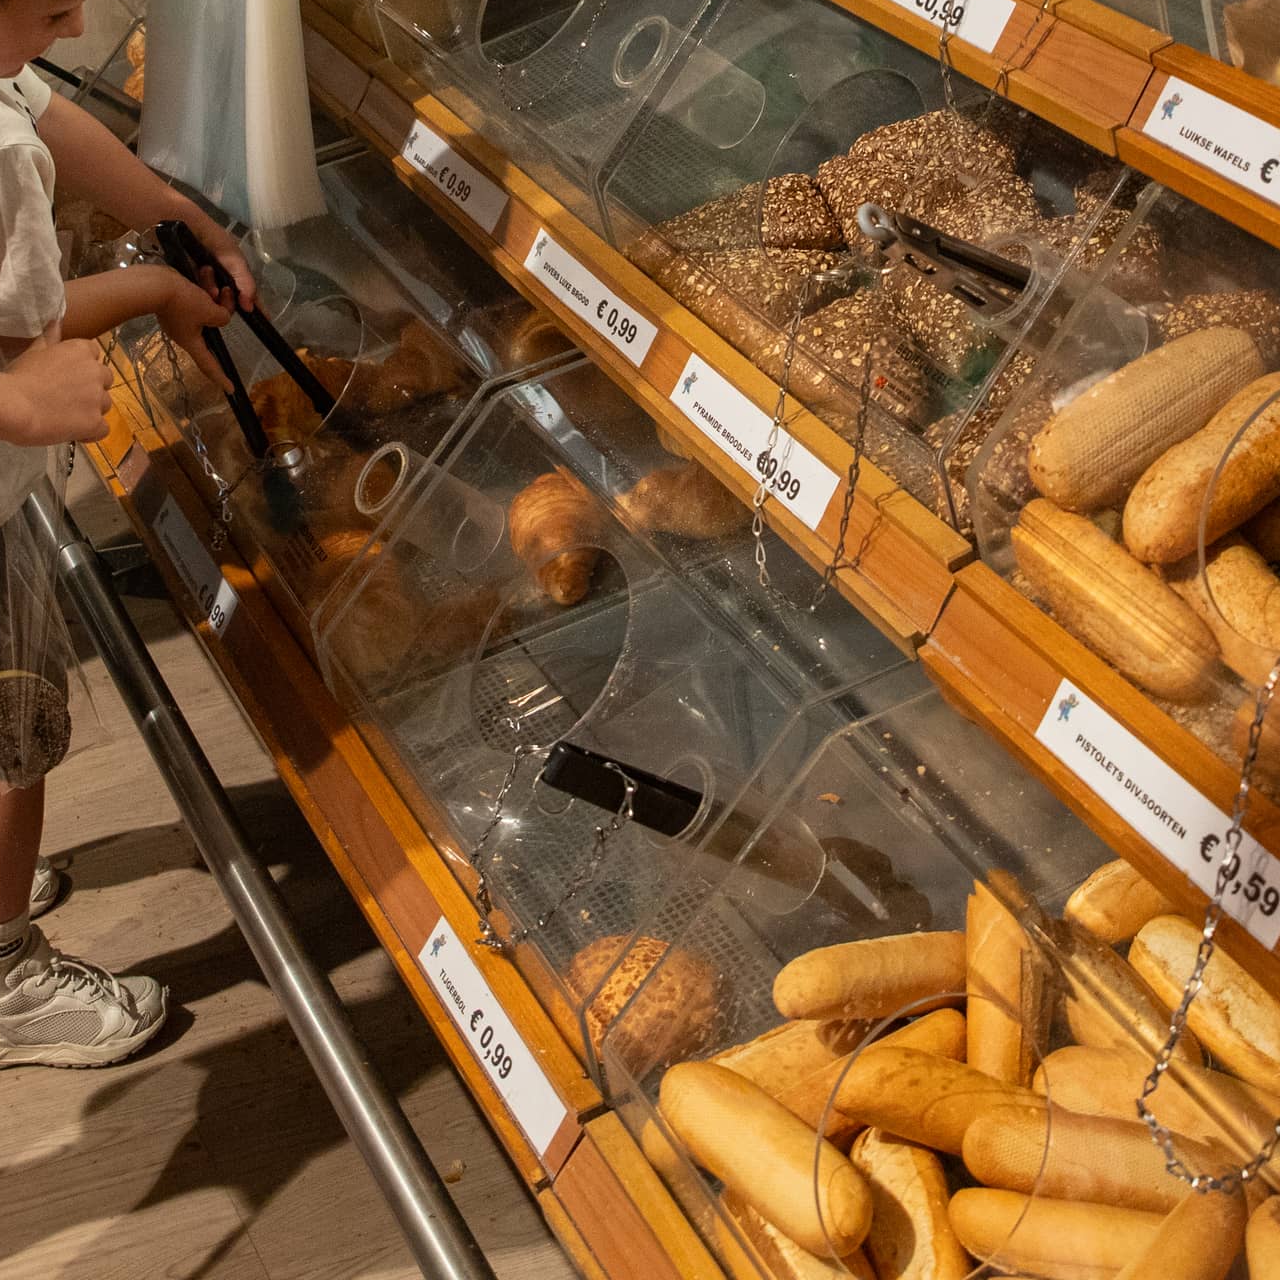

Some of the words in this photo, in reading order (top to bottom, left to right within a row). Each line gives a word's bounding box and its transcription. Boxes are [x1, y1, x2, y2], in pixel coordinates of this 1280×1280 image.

[439, 166, 449, 183] €
[447, 173, 471, 202] 0,99
[1179, 125, 1214, 151] LUIKSE
[1213, 143, 1251, 172] WAFELS
[1259, 158, 1280, 184] €
[543, 262, 560, 281] DIVERS
[559, 276, 572, 292] LUXE
[571, 288, 590, 306] BROOD
[596, 299, 608, 319] €
[607, 308, 638, 344] 0,99
[693, 401, 723, 433] PYRAMIDE
[721, 428, 753, 462] BROODJES
[205, 593, 225, 629] 0,99
[1075, 733, 1125, 782] PISTOLETS
[1123, 777, 1188, 839] DIV.SOORTEN
[1200, 833, 1220, 863] €
[439, 968, 468, 1015] TIJGERBOL
[470, 1009, 484, 1032] €
[480, 1025, 513, 1080] 0,99
